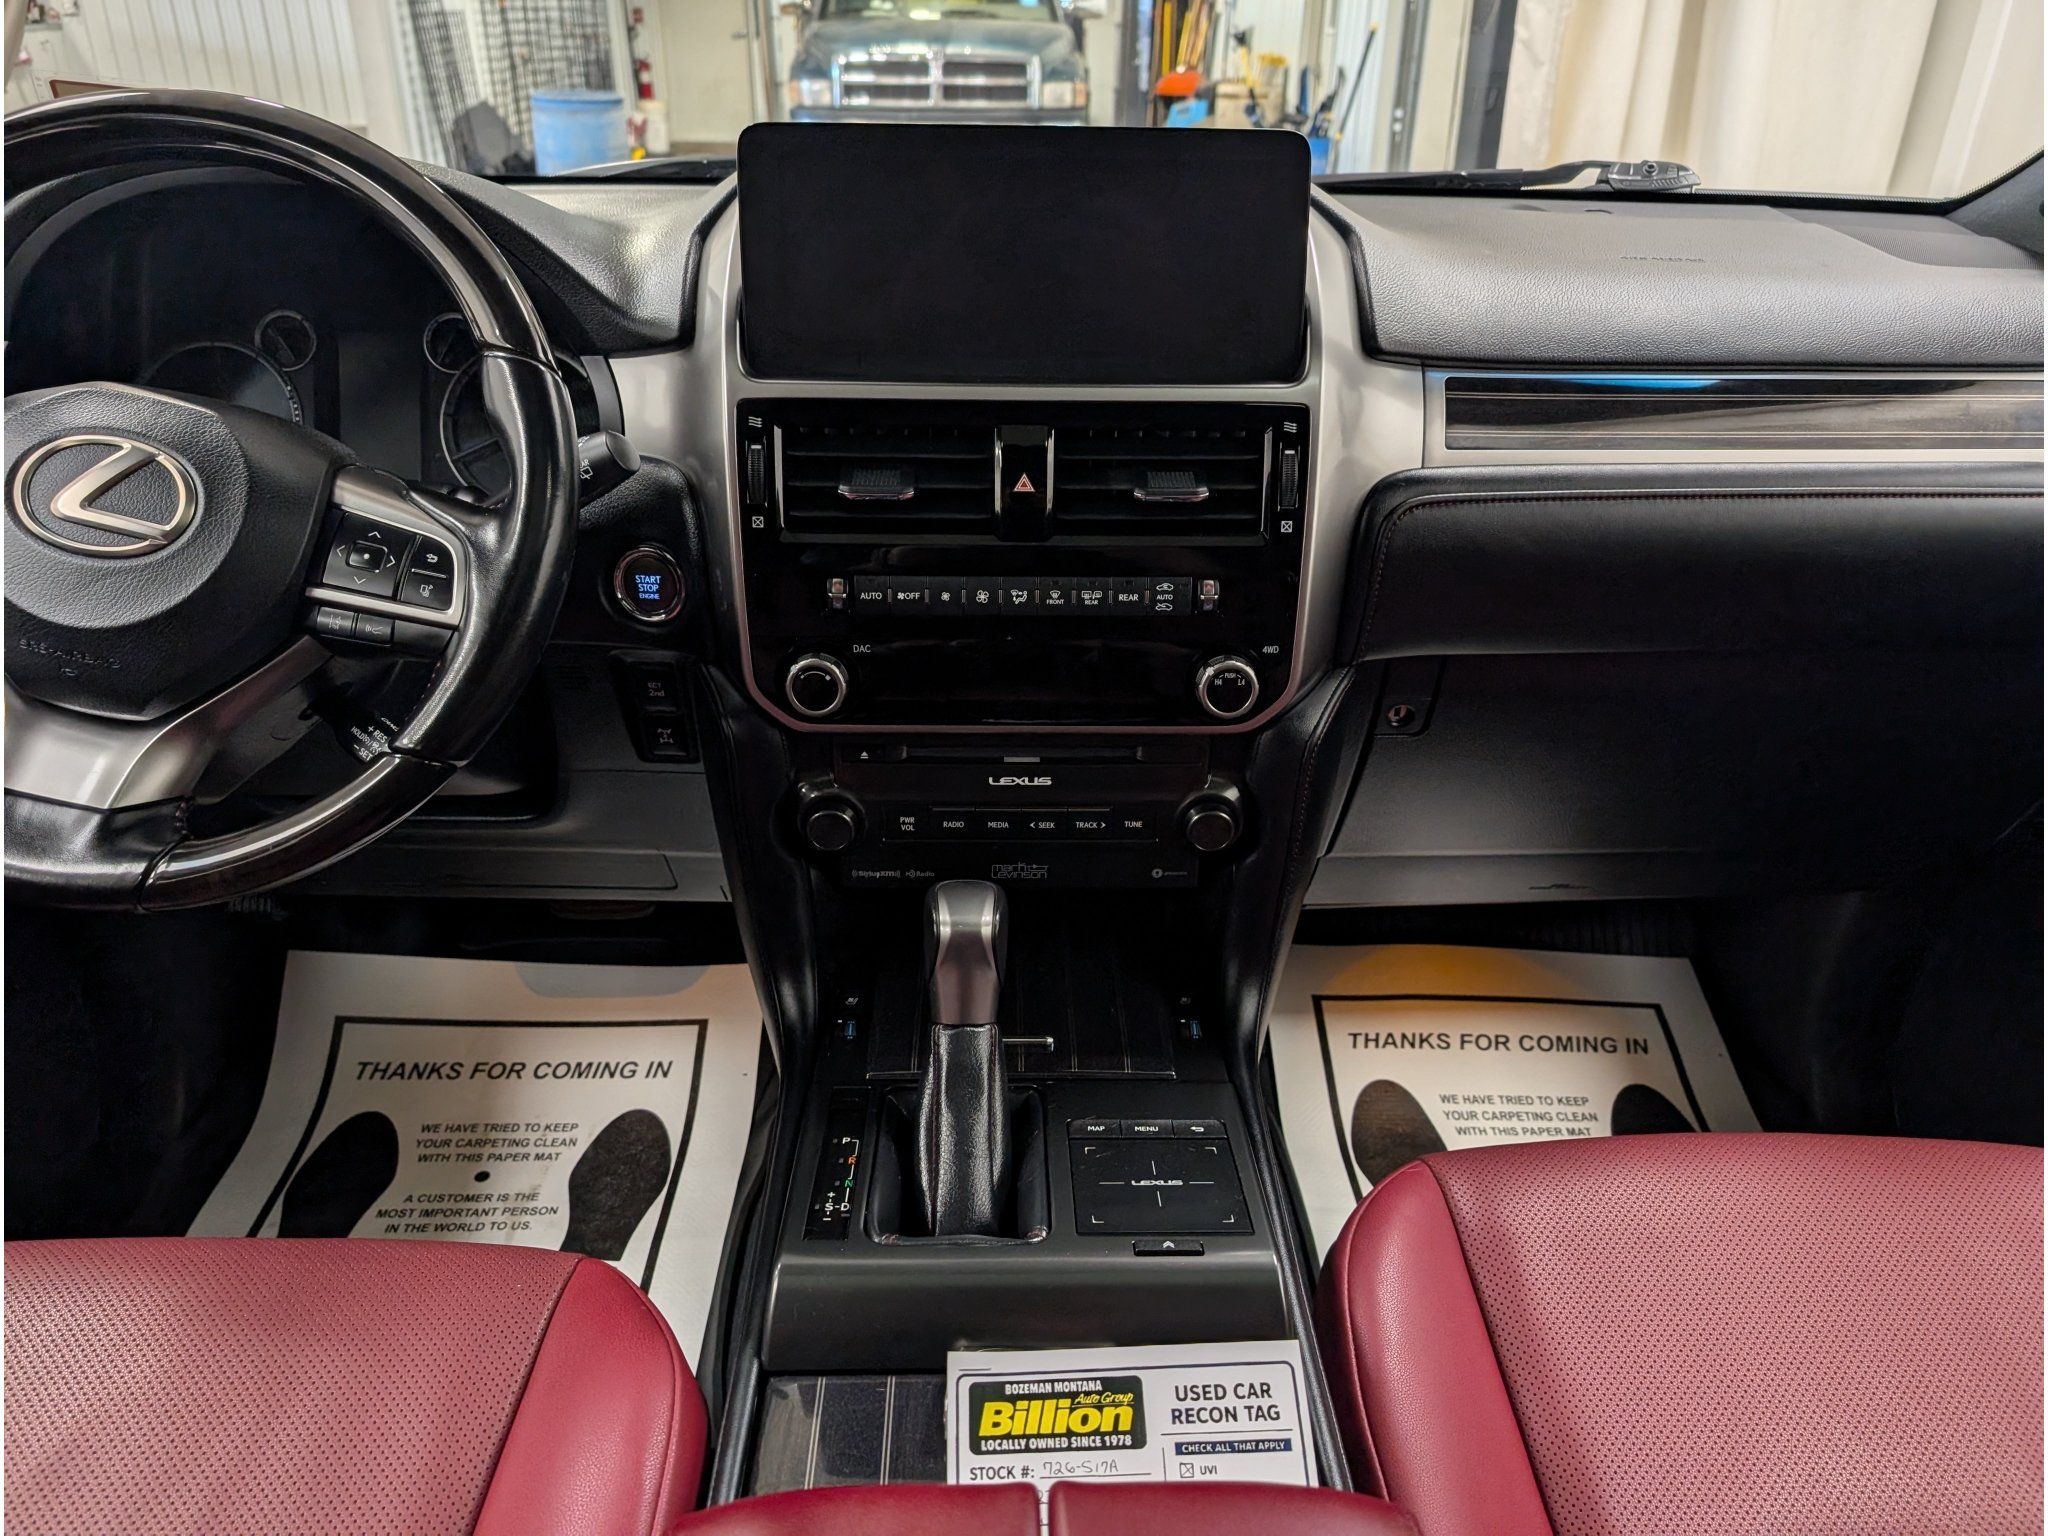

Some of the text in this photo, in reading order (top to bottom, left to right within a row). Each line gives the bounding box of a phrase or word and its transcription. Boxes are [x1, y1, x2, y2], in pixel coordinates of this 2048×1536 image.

[635, 575, 661, 584] START
[638, 584, 659, 592] STOP
[860, 592, 882, 600] AUTO
[904, 592, 920, 600] OFF
[1118, 593, 1139, 602] REAR
[853, 644, 872, 653] DAC
[1262, 645, 1279, 654] 4WD
[373, 729, 387, 743] RES
[359, 747, 373, 761] SET
[988, 776, 1052, 786] LEXUS
[1038, 821, 1055, 829] SEEK
[1076, 821, 1098, 829] TRACK
[1348, 1032, 1649, 1055] THANKS FOR COMING IN
[355, 1060, 673, 1080] THANKS FOR COMING IN
[1439, 1093, 1589, 1106] WE HAVE TRIED TO KEEP
[1443, 1110, 1599, 1122] YOUR CARPETING CLEAN
[421, 1123, 579, 1133] WE HAVE TRIED TO KEEP
[1455, 1126, 1592, 1137] WITH THIS PAPER MAT
[416, 1138, 578, 1148] YOUR CARPETING CLEAN
[417, 1152, 561, 1163] WITH THIS PAPER MAT
[848, 1156, 857, 1165] R
[844, 1180, 854, 1188] N
[403, 1192, 540, 1203] A CUSTOMER IS THE
[376, 1206, 559, 1218] MOST IMPORTANT PERSON
[384, 1221, 532, 1233] IN THE WORLD TO US.
[1005, 1380, 1103, 1395] BOZEMAN MONTANA
[1174, 1382, 1272, 1402] USED CAR
[1074, 1392, 1134, 1405] Auto Group
[978, 1398, 1134, 1437] Billion
[1171, 1404, 1281, 1425] RECON TAG
[981, 1435, 1132, 1451] LOCALLY OWNED SINCE 1978
[1181, 1441, 1285, 1453] CHECK ALL THAT APPLY
[969, 1465, 1035, 1481] STOCK #:
[1200, 1465, 1217, 1475] UVI
